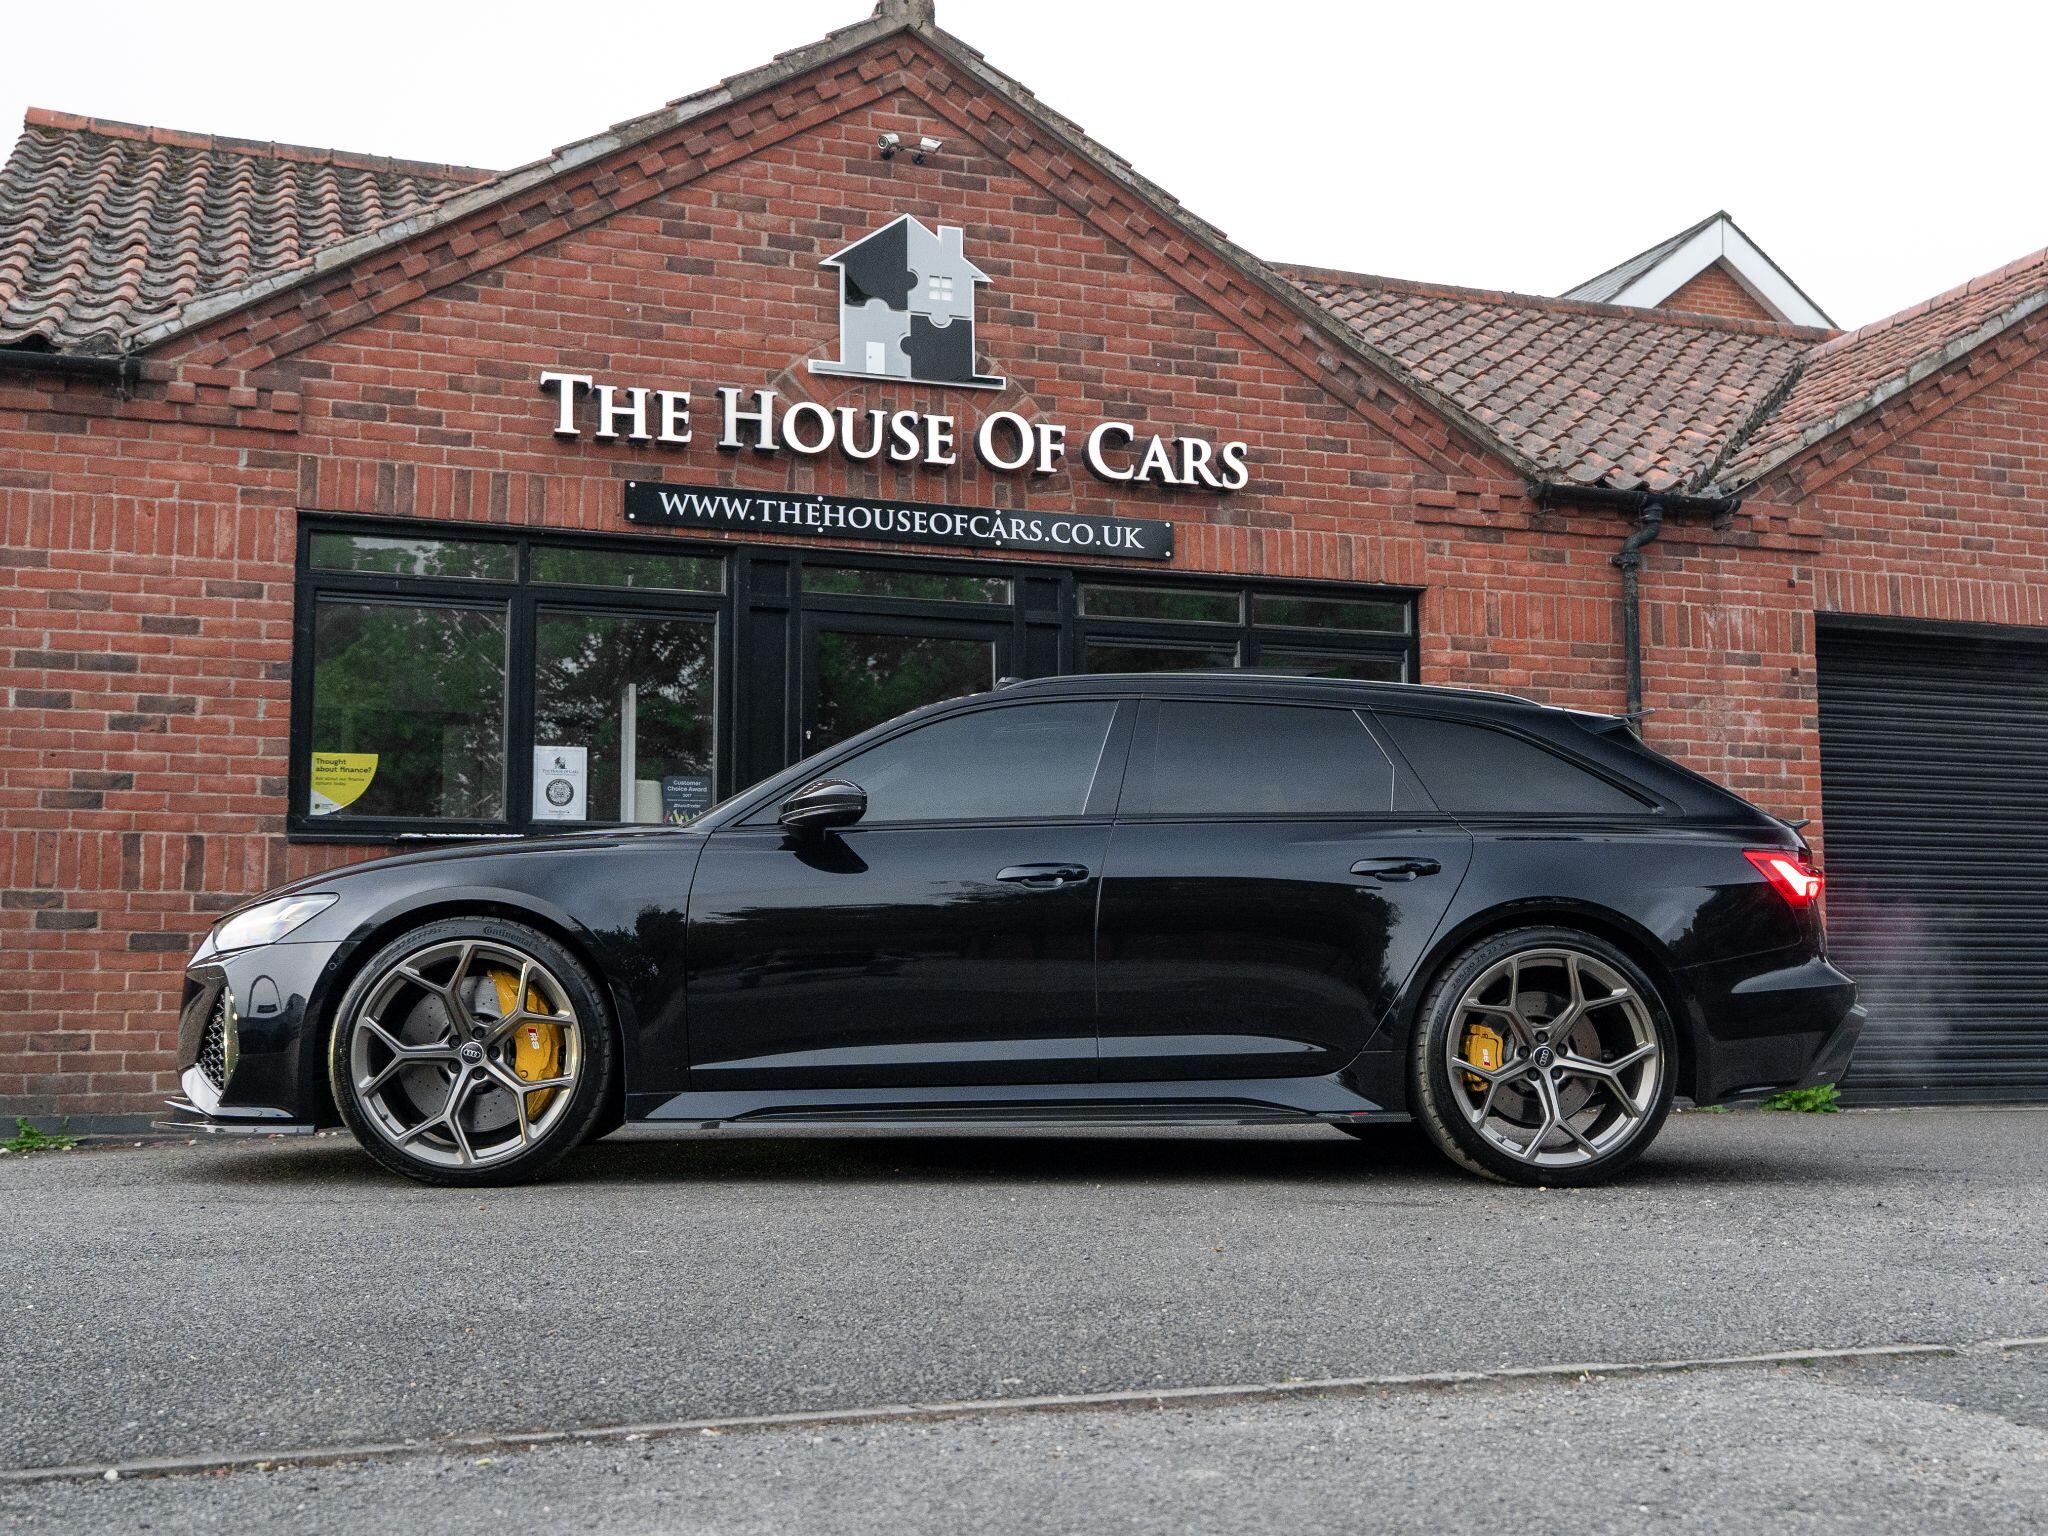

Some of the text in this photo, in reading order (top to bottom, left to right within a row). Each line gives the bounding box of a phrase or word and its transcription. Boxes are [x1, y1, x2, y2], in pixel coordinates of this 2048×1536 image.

[541, 371, 1249, 490] THE HOUSE OF CARS
[658, 491, 1145, 550] WWW.THEHOUSEOFCARS.CO.UK
[316, 758, 346, 766] Thought
[340, 766, 371, 774] finance?
